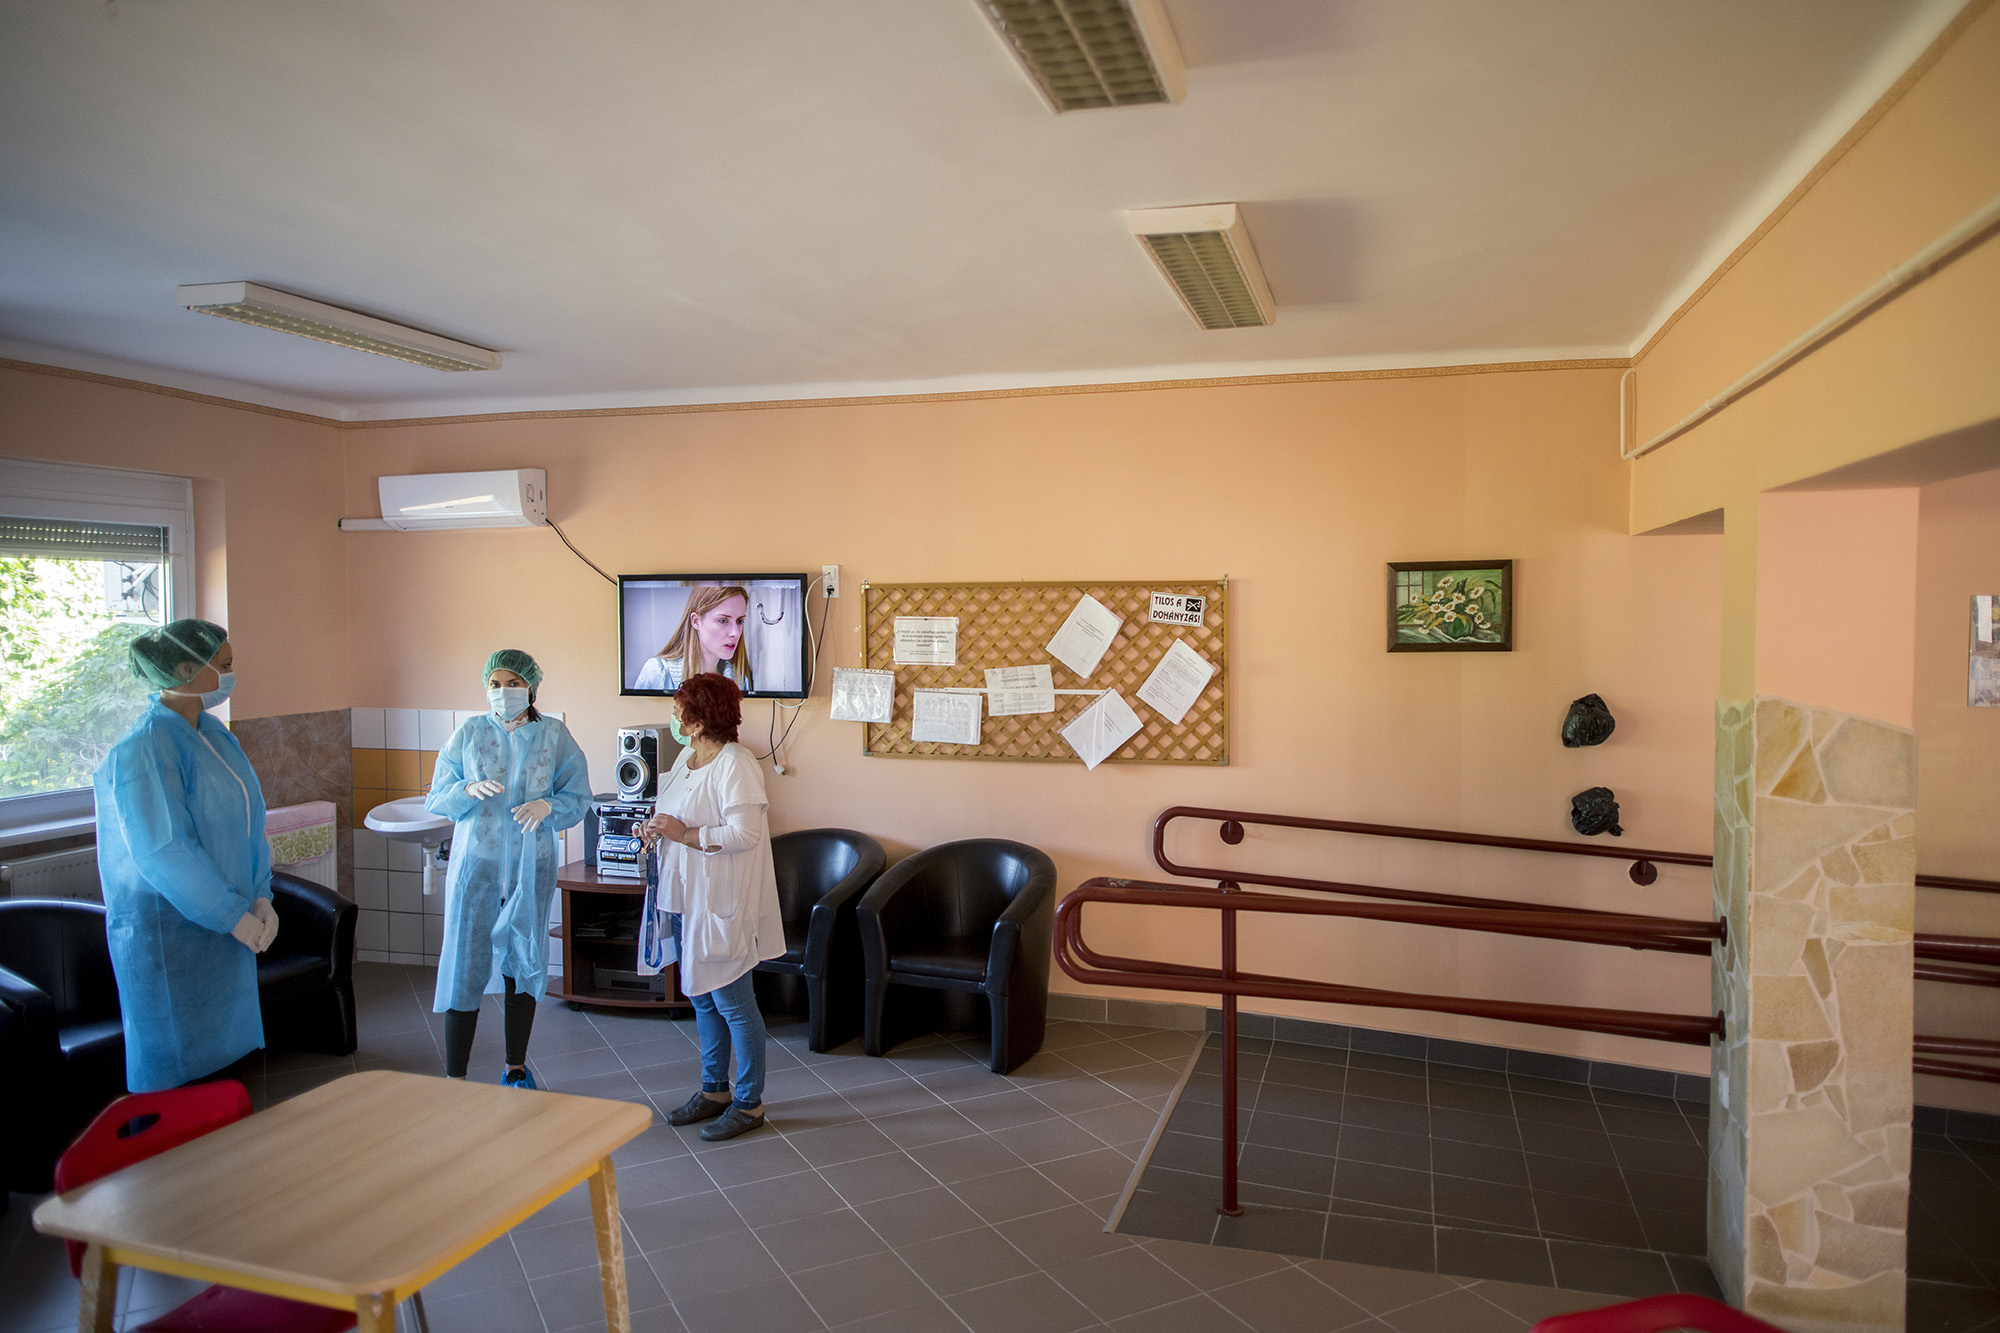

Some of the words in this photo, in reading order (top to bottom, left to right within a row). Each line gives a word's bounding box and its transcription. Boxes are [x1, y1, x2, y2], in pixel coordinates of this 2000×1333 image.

[1154, 596, 1175, 606] TILOS
[1176, 598, 1182, 607] A
[1153, 610, 1201, 623] DOHÁNYZÁS!
